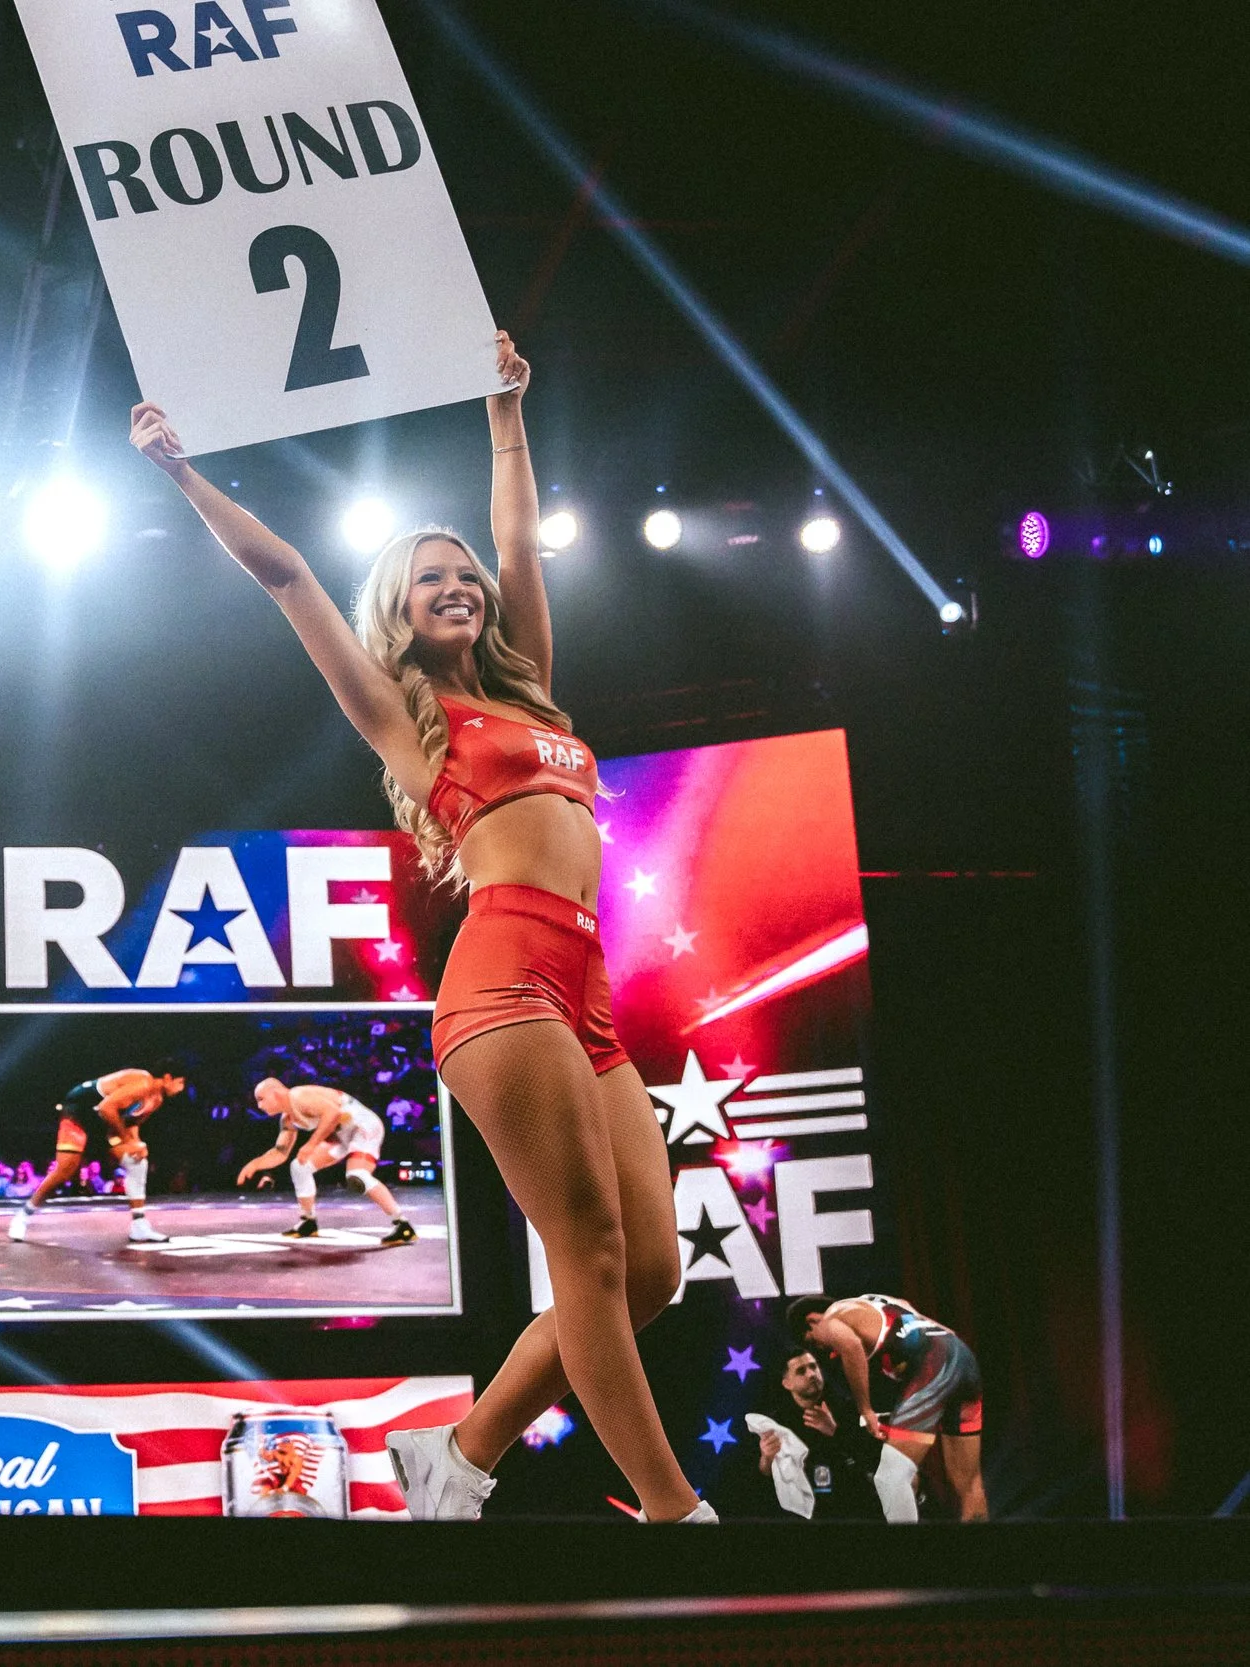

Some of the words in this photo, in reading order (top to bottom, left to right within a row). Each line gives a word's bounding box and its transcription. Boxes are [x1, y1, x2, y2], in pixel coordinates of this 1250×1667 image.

[115, 0, 298, 77] RAF
[73, 99, 422, 221] ROUND
[248, 224, 370, 392] 2
[534, 739, 584, 771] RAF
[3, 846, 392, 989] RAF
[576, 911, 595, 934] RAF
[525, 1153, 874, 1315] AF
